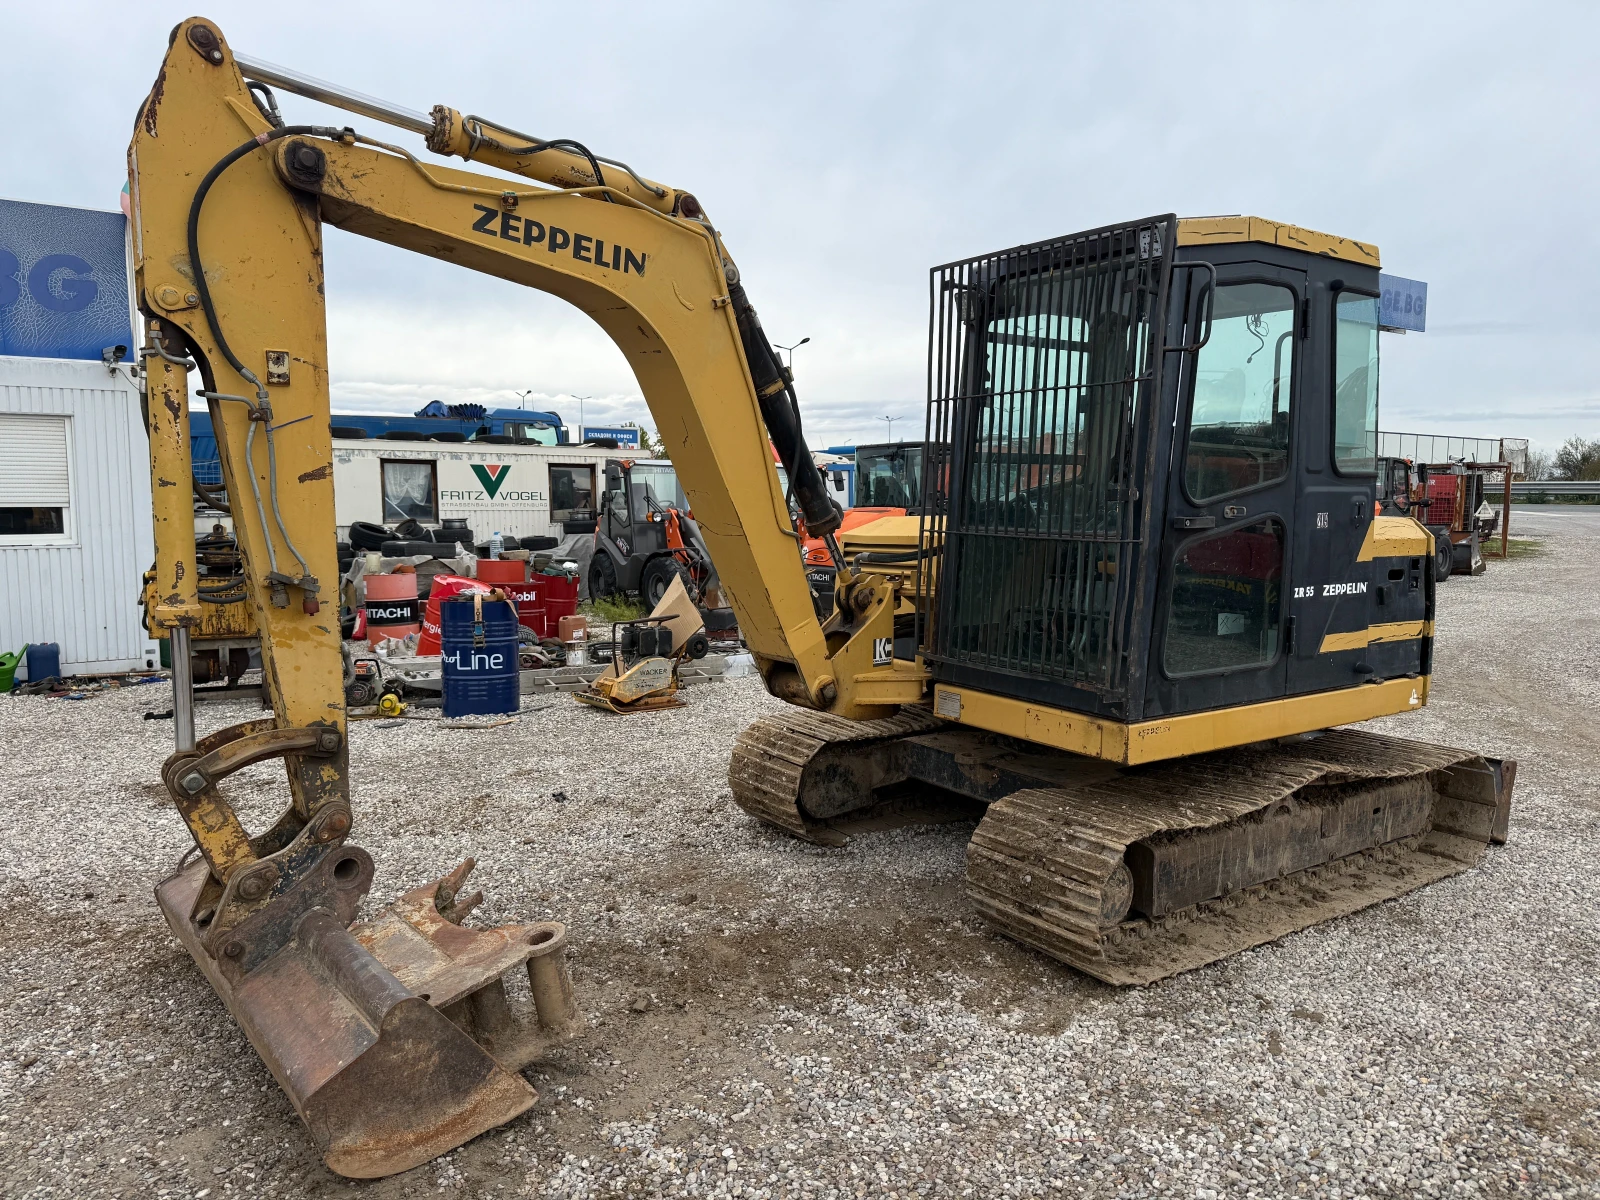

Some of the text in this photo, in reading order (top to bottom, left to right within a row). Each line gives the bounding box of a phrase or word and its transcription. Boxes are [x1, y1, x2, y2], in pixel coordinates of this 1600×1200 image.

[472, 203, 647, 277] ZEPPELIN
[441, 491, 548, 500] FRITZ VOGEL
[1294, 582, 1367, 598] ZR 55 ZEPPELIN
